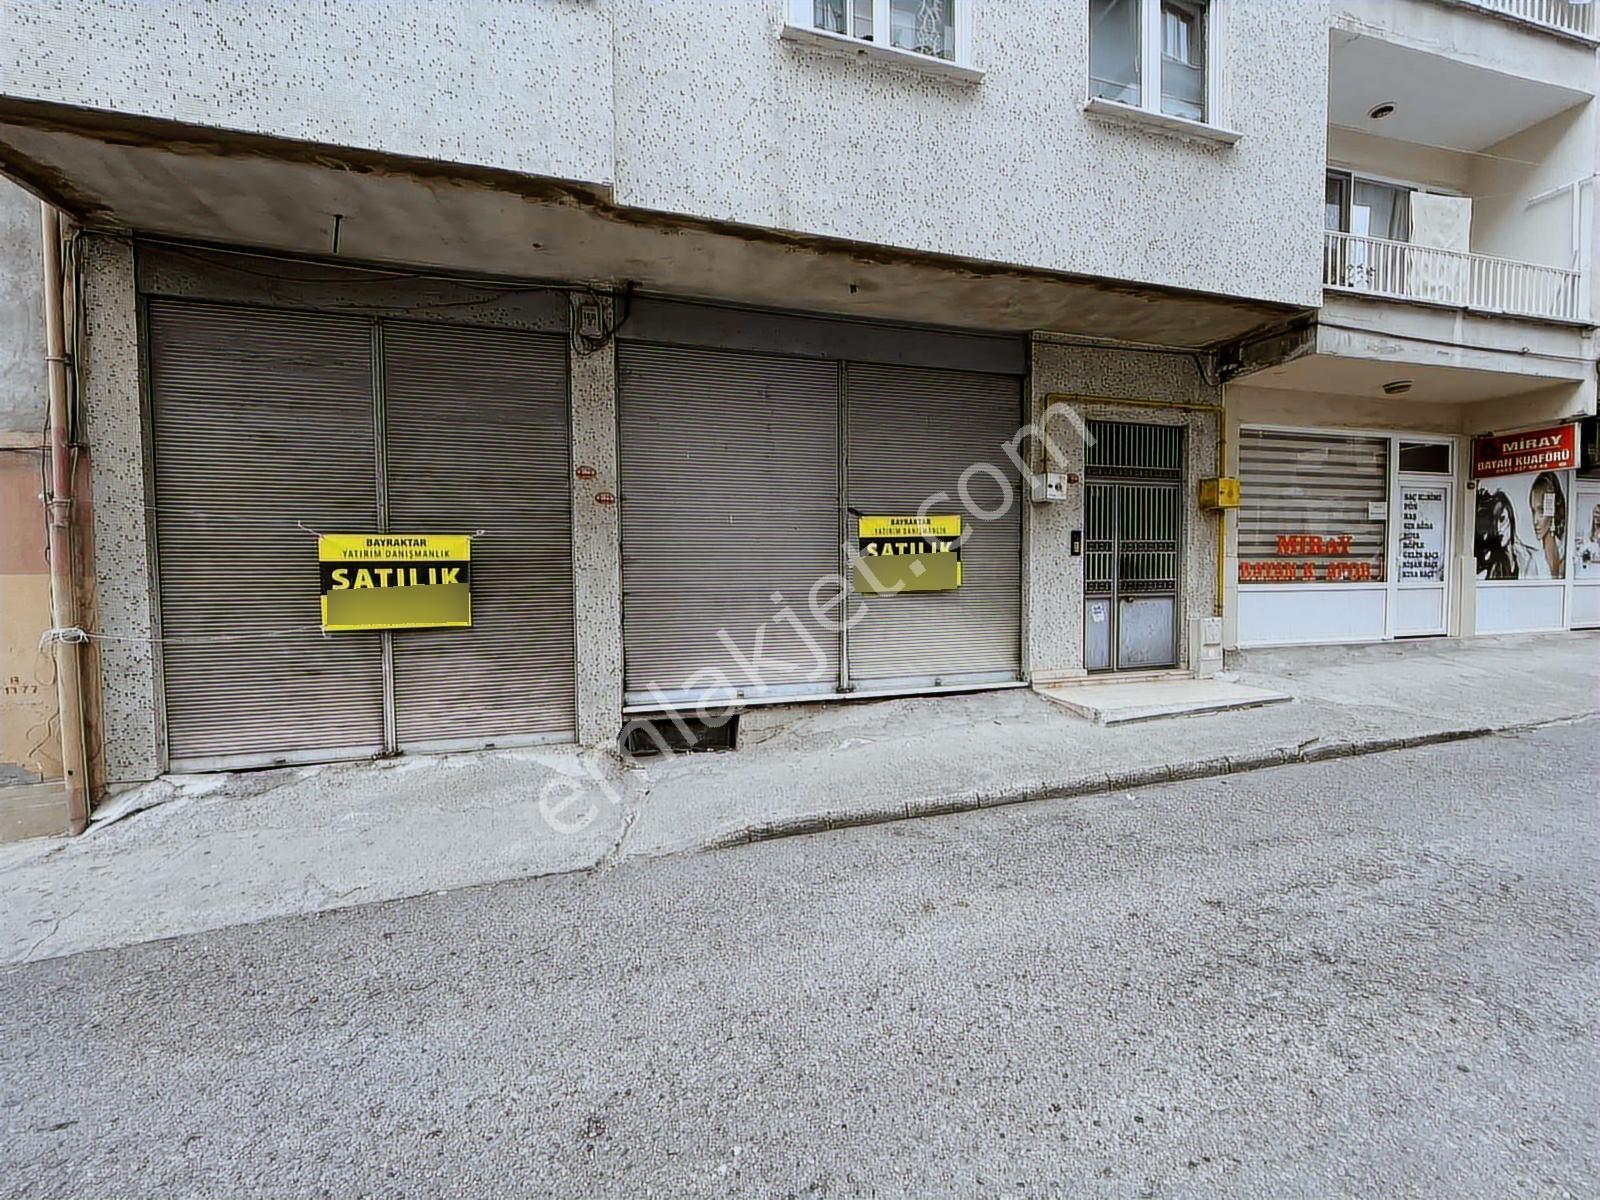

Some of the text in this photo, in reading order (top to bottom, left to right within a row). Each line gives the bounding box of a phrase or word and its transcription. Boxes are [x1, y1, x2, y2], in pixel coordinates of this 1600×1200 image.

[366, 539, 428, 547] BAYRAKTAR
[342, 550, 450, 559] YATIRIM DANIŞMANLIK
[330, 567, 461, 590] SATILIK
